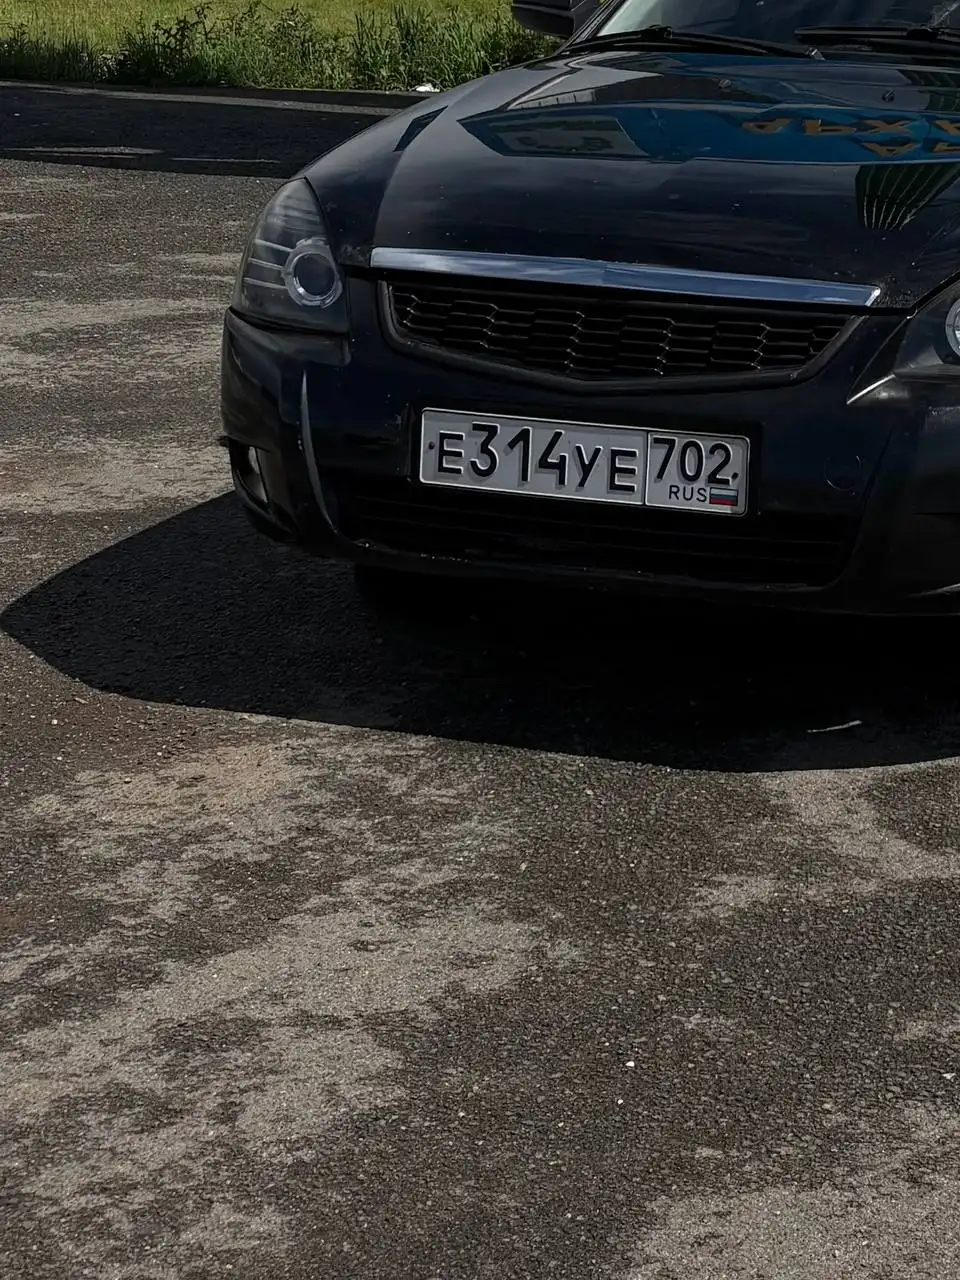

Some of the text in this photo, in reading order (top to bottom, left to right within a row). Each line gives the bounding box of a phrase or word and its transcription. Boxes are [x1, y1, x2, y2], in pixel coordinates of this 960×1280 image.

[437, 421, 732, 493] Е314УЕ 702
[669, 485, 708, 503] RUS
